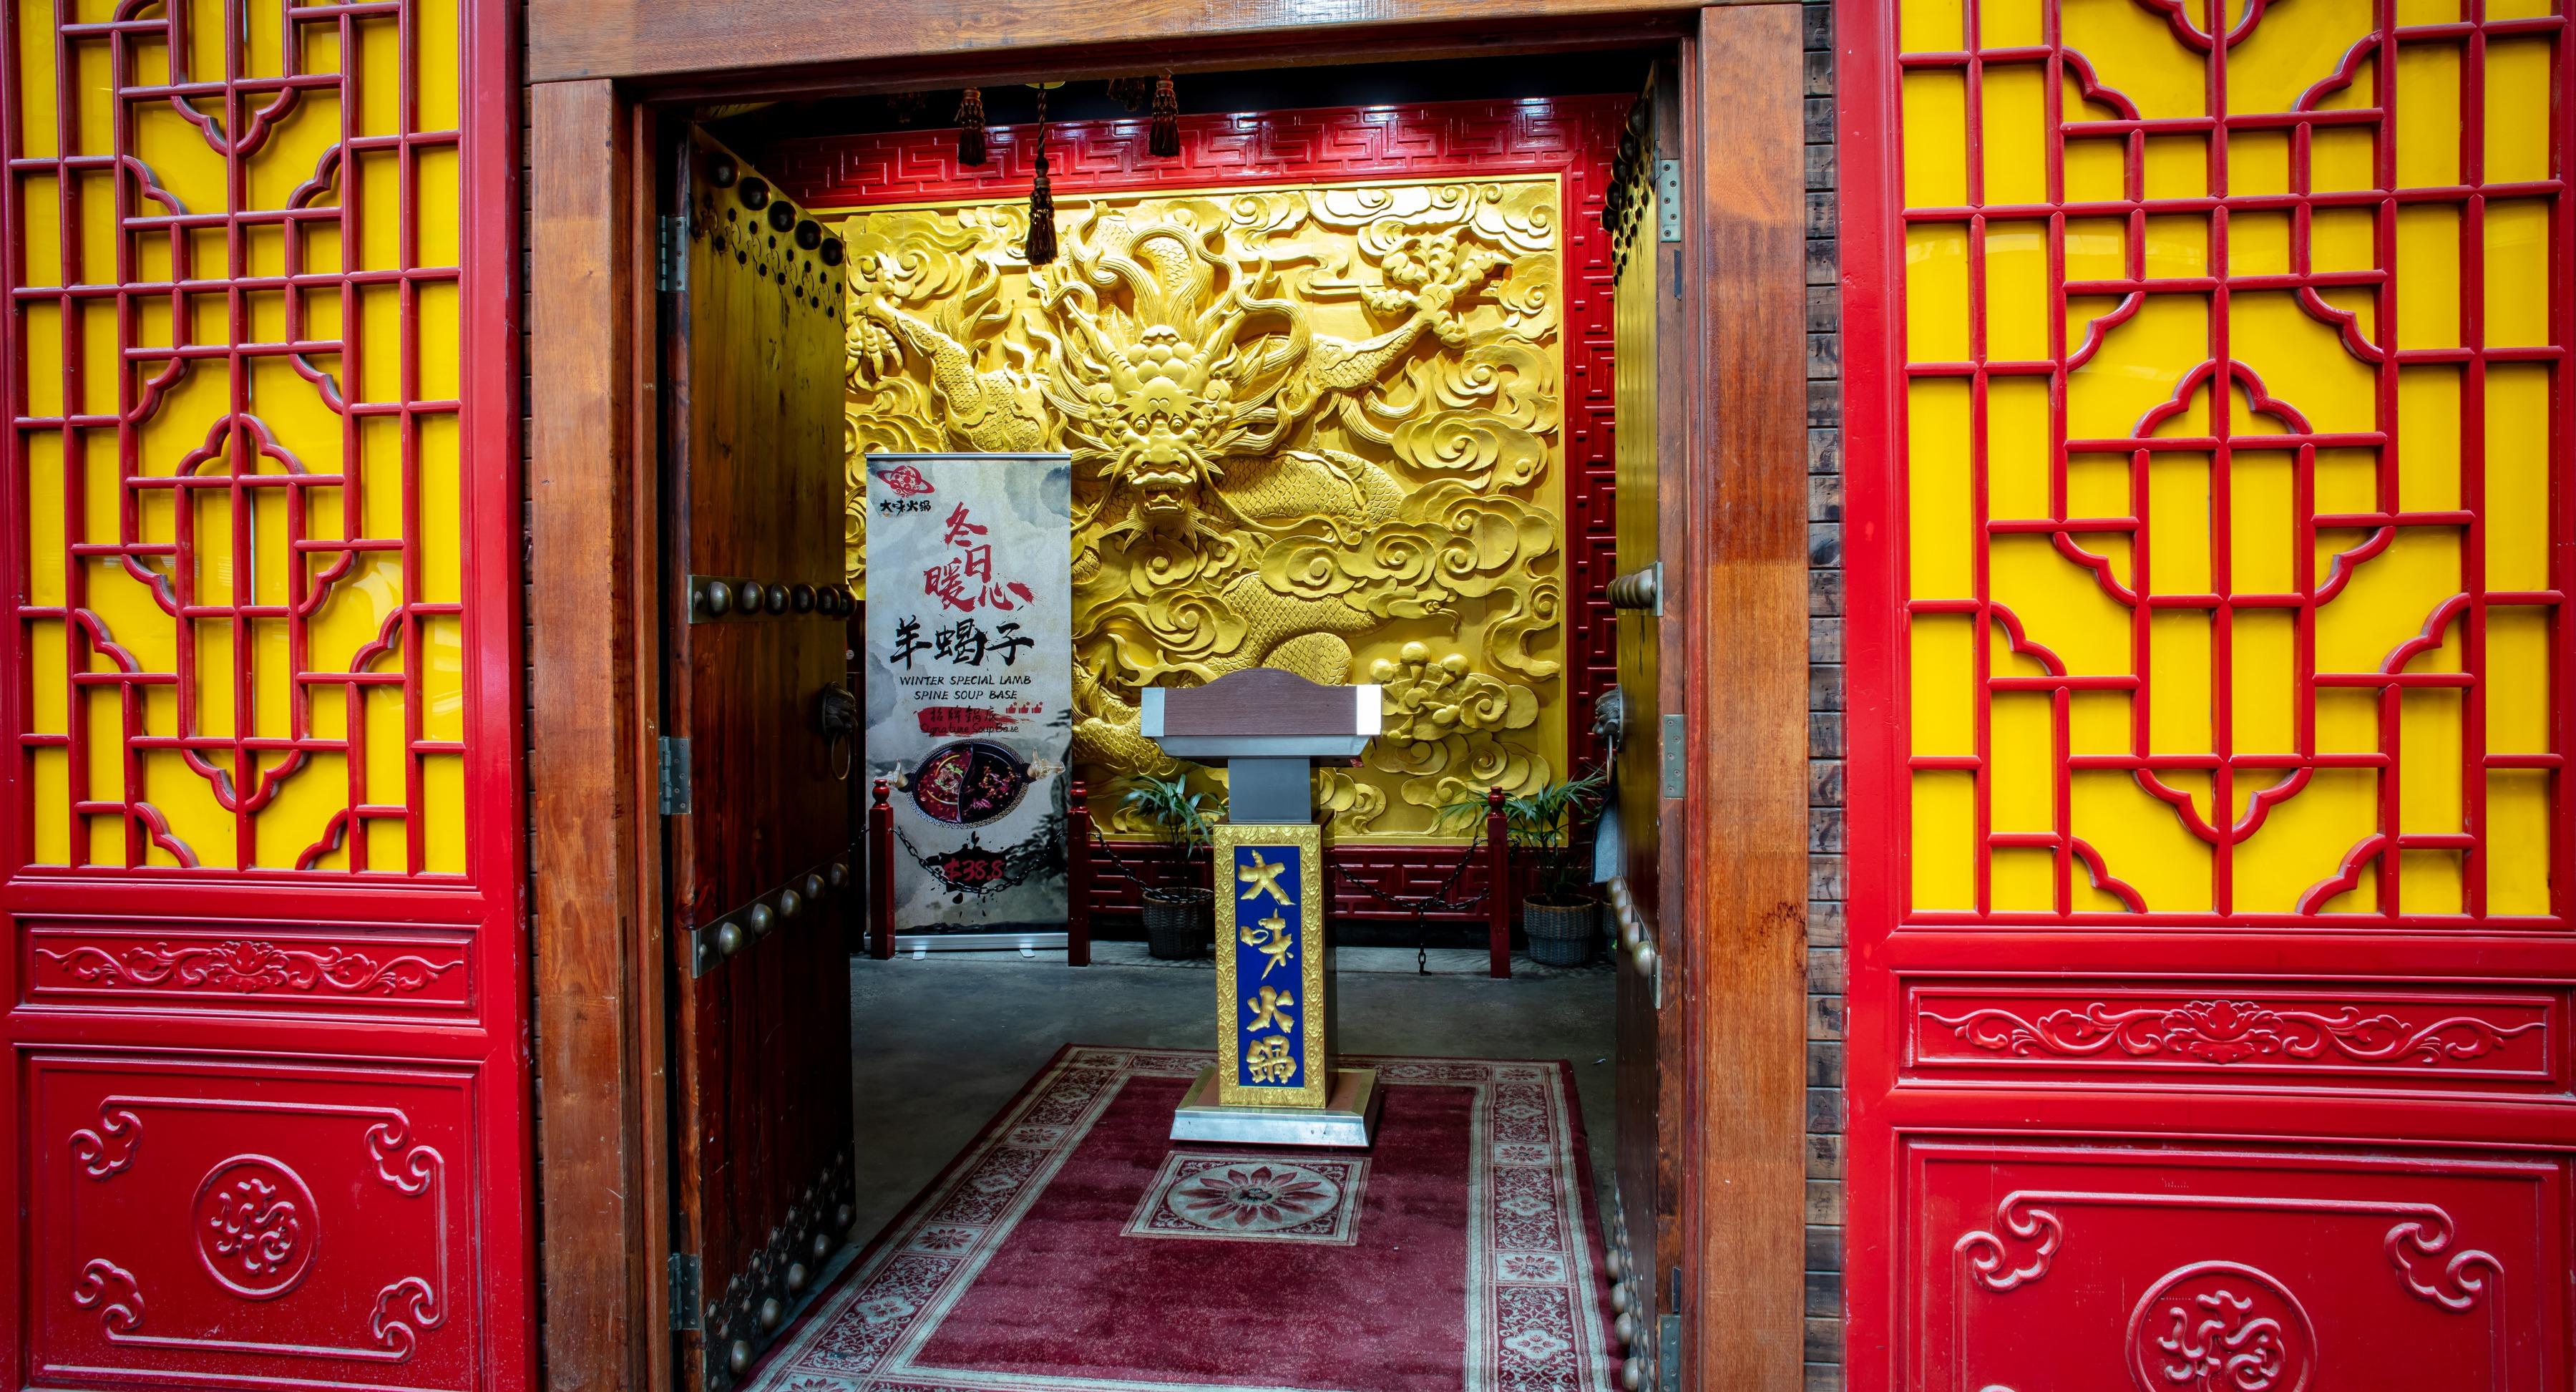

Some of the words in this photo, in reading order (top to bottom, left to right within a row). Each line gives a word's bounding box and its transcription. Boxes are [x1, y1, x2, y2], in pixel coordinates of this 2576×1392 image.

[899, 676, 945, 686] WINTER
[949, 674, 995, 686] SPECIAL
[1000, 675, 1032, 685] LAMB
[914, 691, 948, 700] SPINE
[953, 691, 983, 700] SOUP
[989, 690, 1018, 699] BASE
[920, 724, 970, 737] Signature
[972, 723, 995, 736] Soup
[995, 723, 1020, 733] Base
[945, 858, 1005, 882] $38.8
